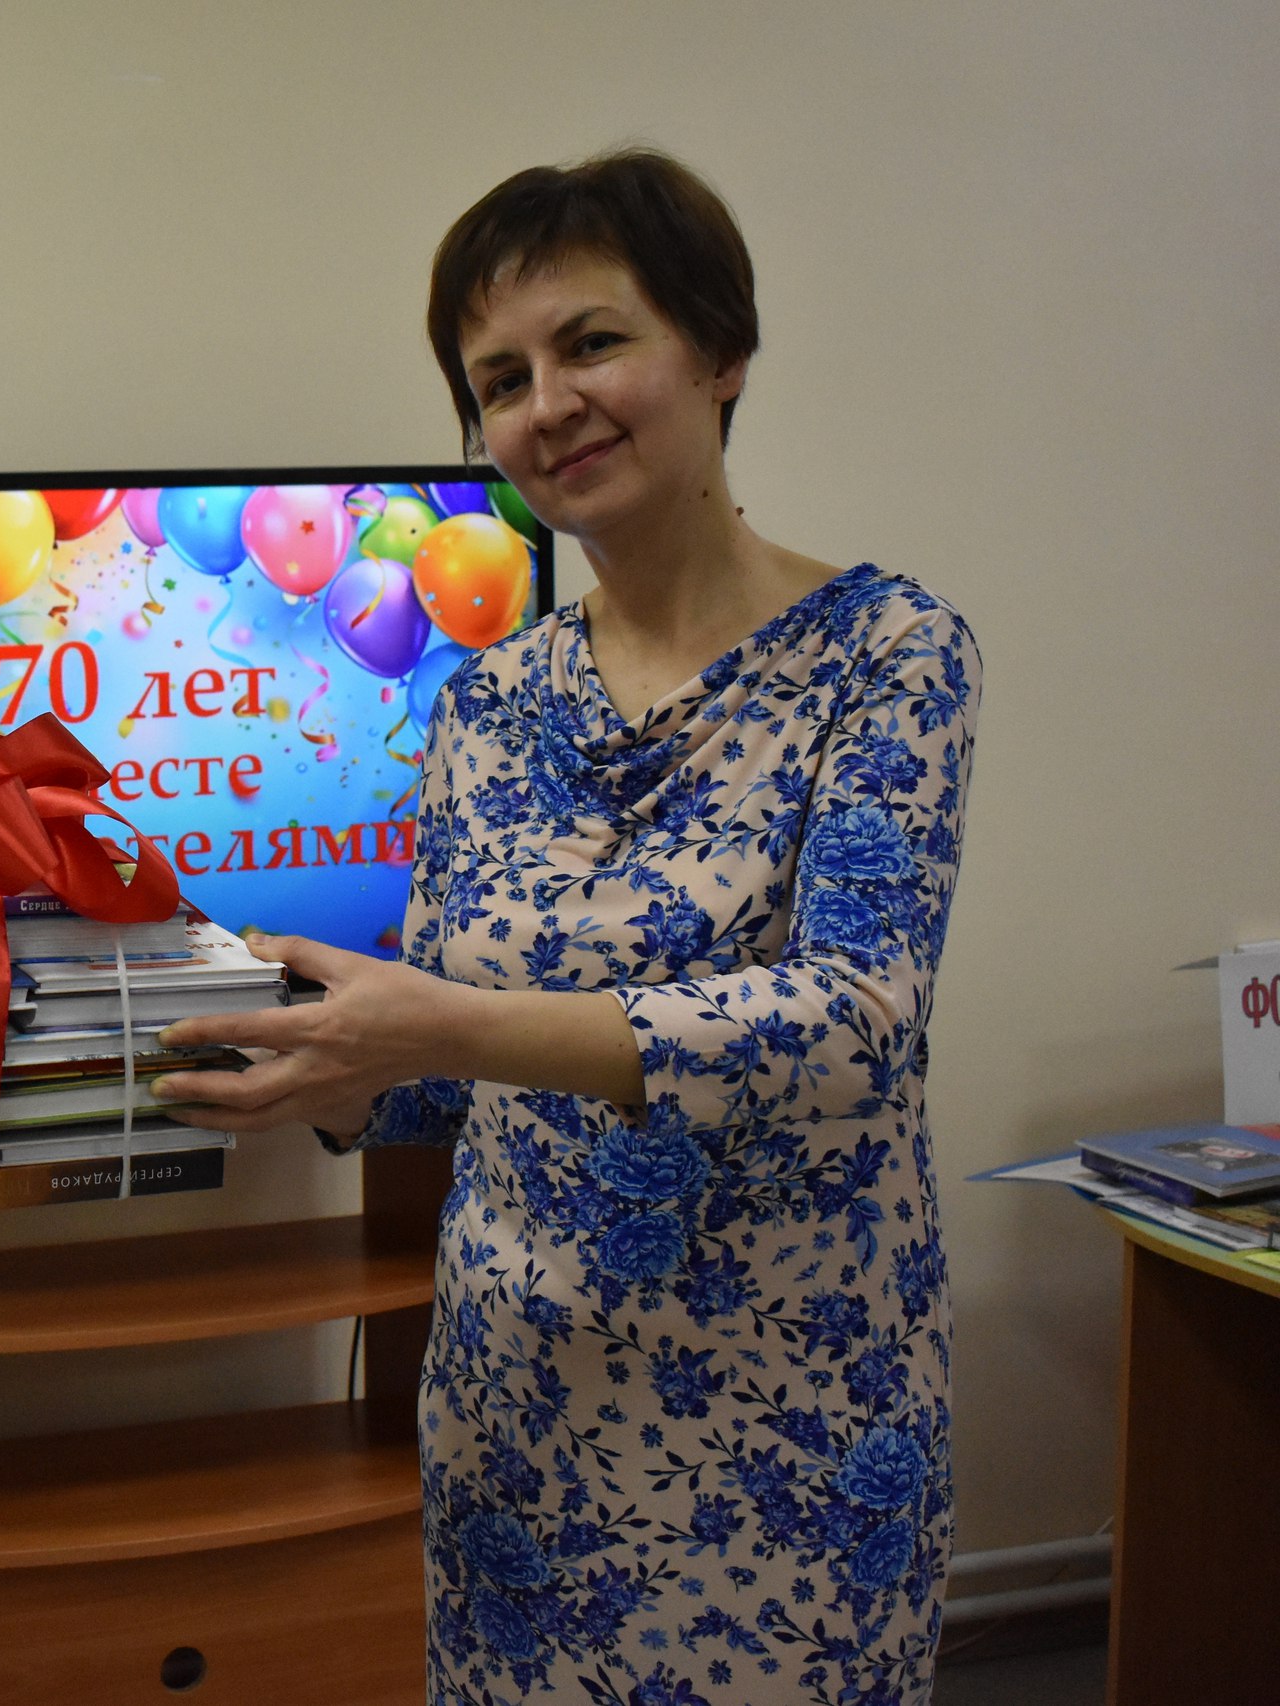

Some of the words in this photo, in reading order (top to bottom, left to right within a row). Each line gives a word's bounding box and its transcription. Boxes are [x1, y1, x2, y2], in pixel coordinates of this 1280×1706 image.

[126, 667, 277, 720] лет
[87, 753, 264, 802] есте
[51, 1171, 121, 1190] РУДАКОВ
[129, 1166, 183, 1185] СЕРГЕЙ
